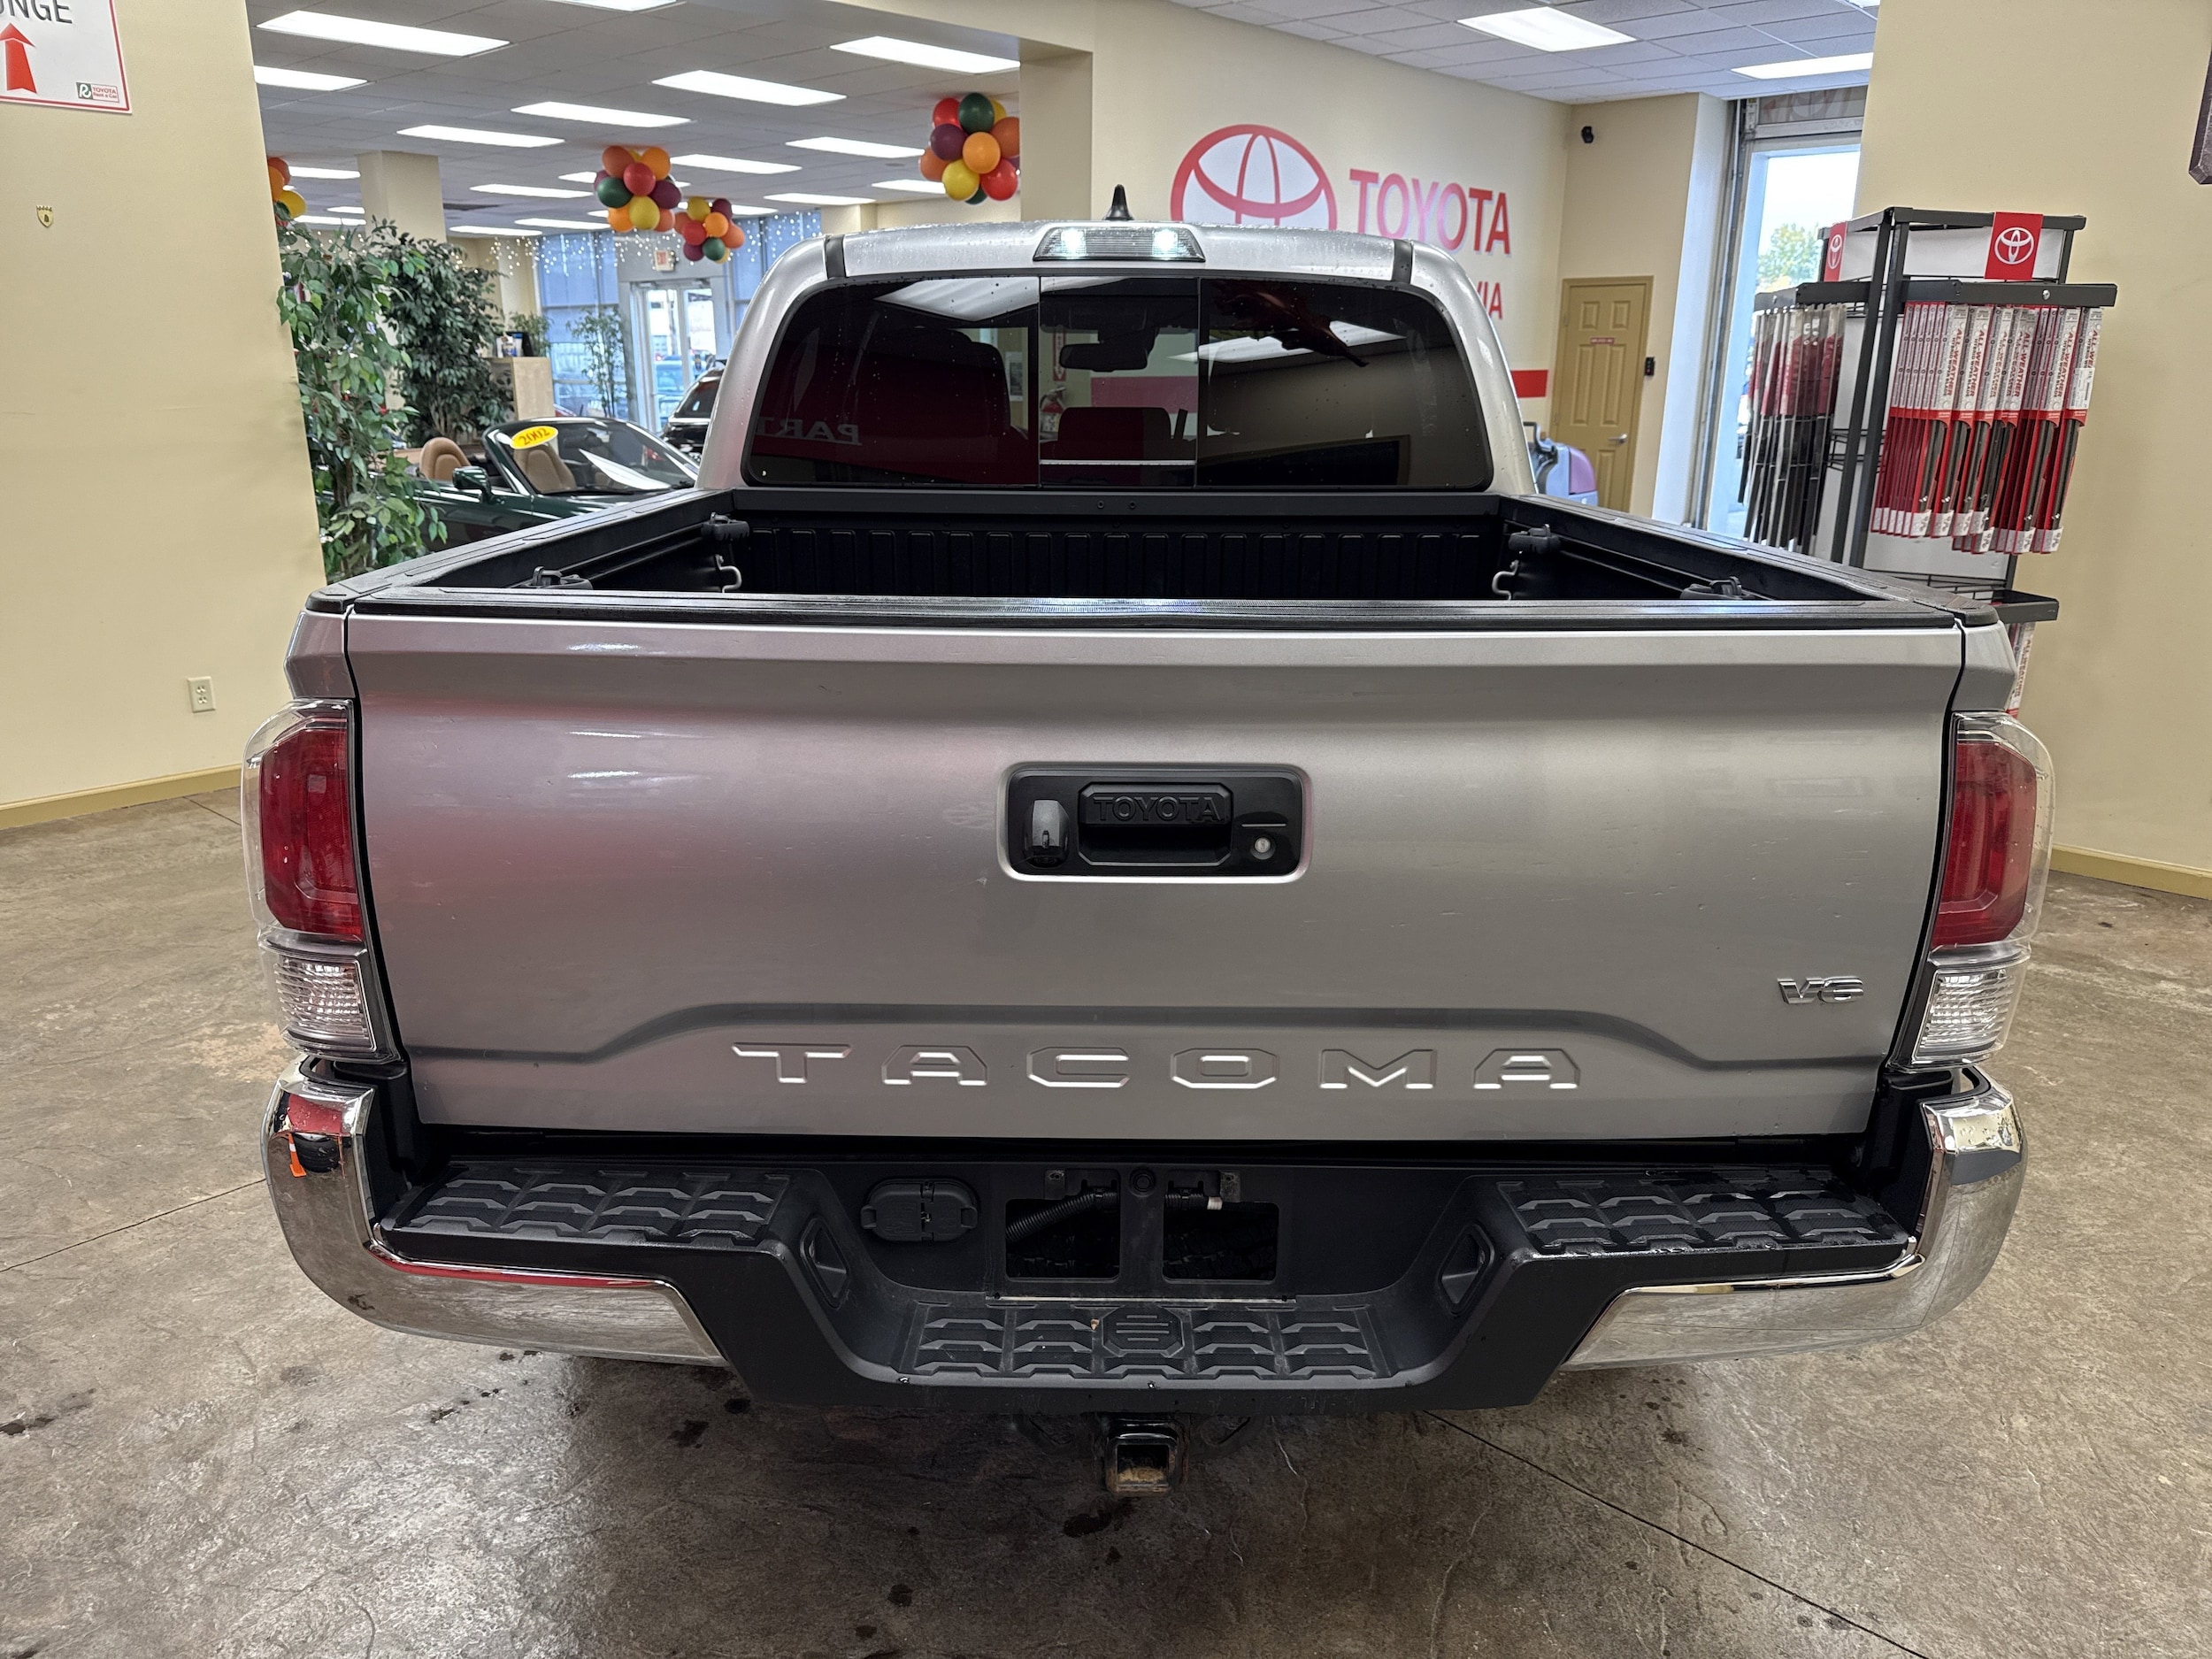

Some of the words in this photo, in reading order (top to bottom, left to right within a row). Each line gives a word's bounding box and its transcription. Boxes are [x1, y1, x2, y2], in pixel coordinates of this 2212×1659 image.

[0, 0, 73, 24] NGE
[1349, 168, 1511, 255] TOYOTA
[2014, 332, 2031, 396] ALL-WEATHER
[518, 427, 550, 446] 2002
[1093, 795, 1222, 822] TOYOTA
[1777, 975, 1864, 1004] V6
[732, 1042, 1581, 1088] TACOMA
